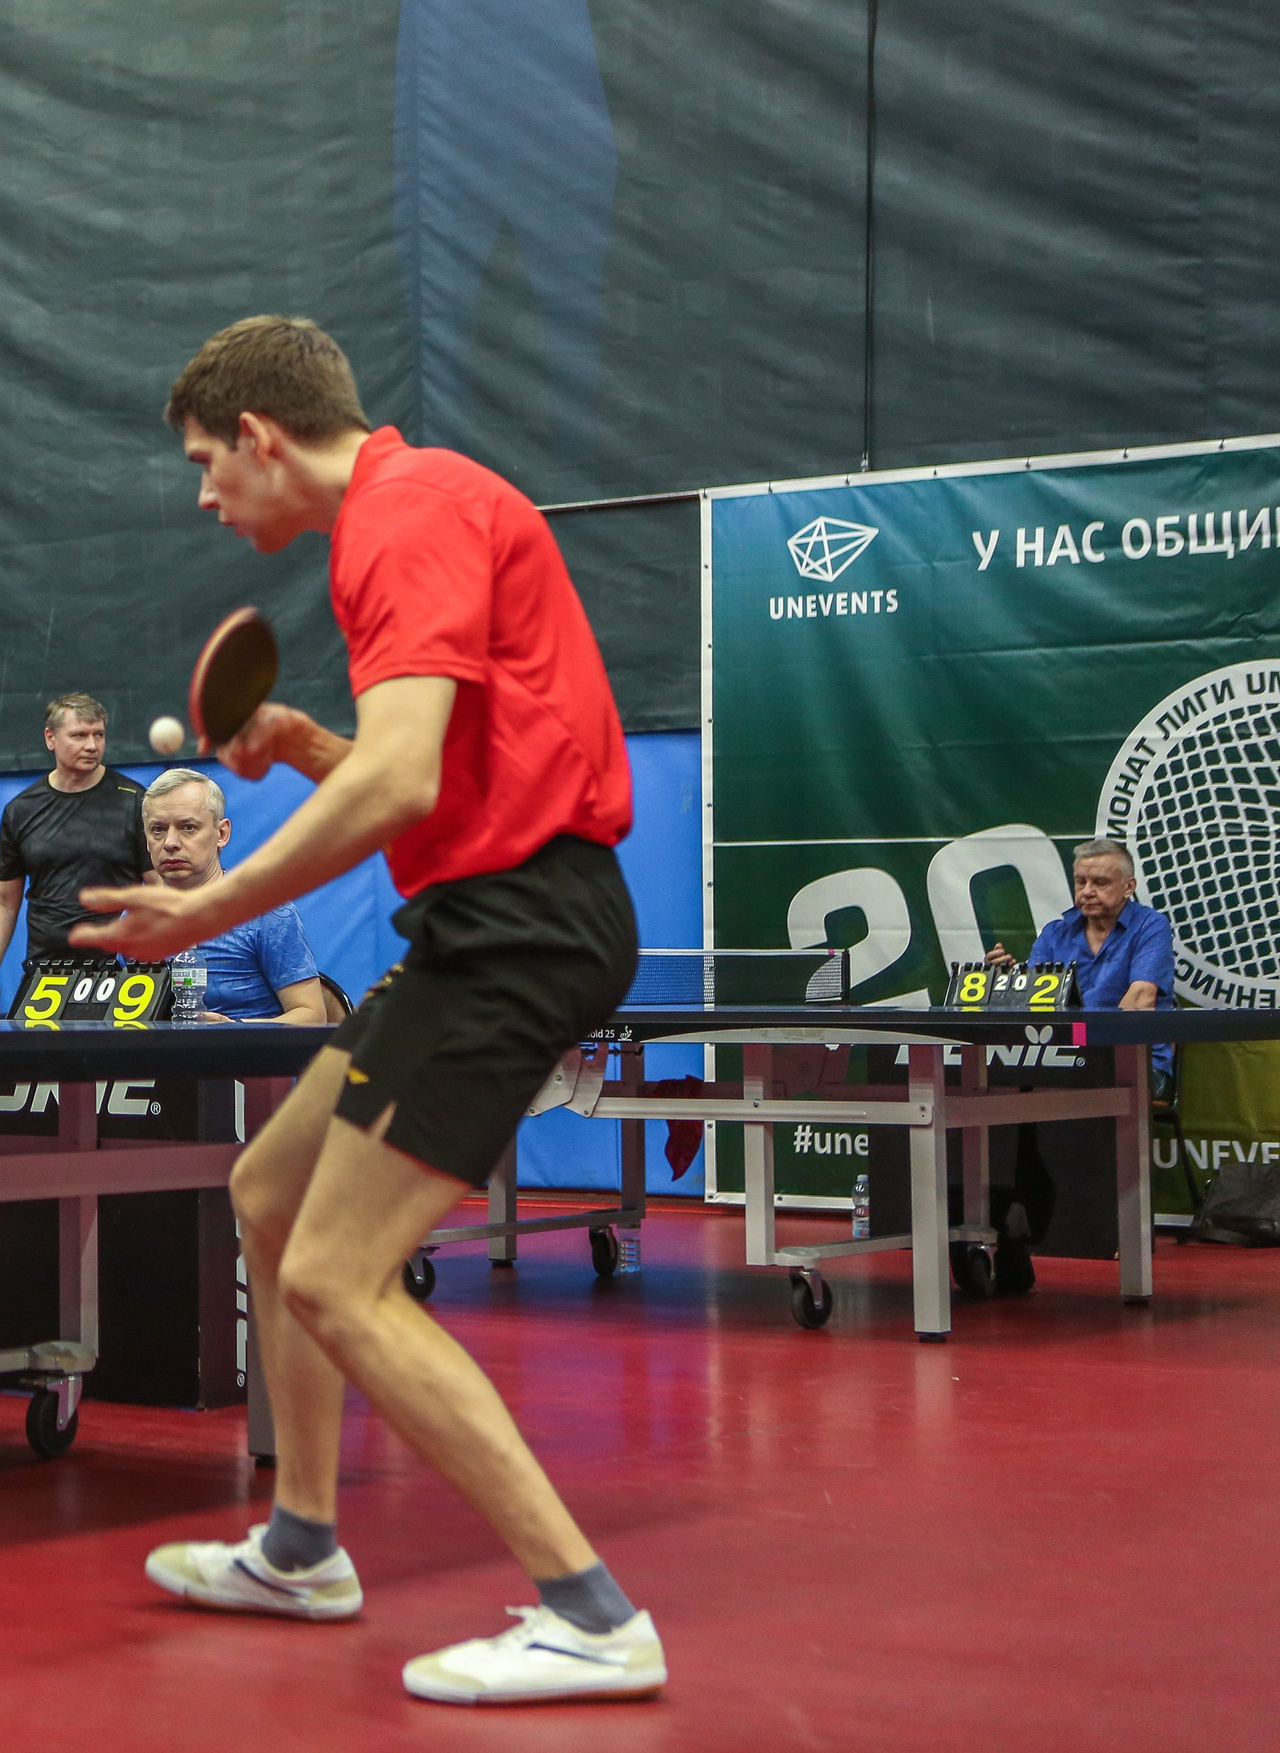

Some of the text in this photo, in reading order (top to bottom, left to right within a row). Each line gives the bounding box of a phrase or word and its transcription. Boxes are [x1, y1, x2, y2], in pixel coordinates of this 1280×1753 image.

[972, 506, 1280, 571] У НАС ОБЩИ
[769, 588, 899, 620] UNEVENTS
[1106, 736, 1157, 845] ИОНАТ
[1155, 678, 1236, 741] ЛИГИ
[24, 976, 69, 1020] 5
[73, 977, 93, 1002] 0
[96, 977, 116, 1002] 0
[113, 974, 155, 1021] 9
[959, 972, 1060, 1004] 8 2 0 2
[604, 1029, 615, 1038] 25
